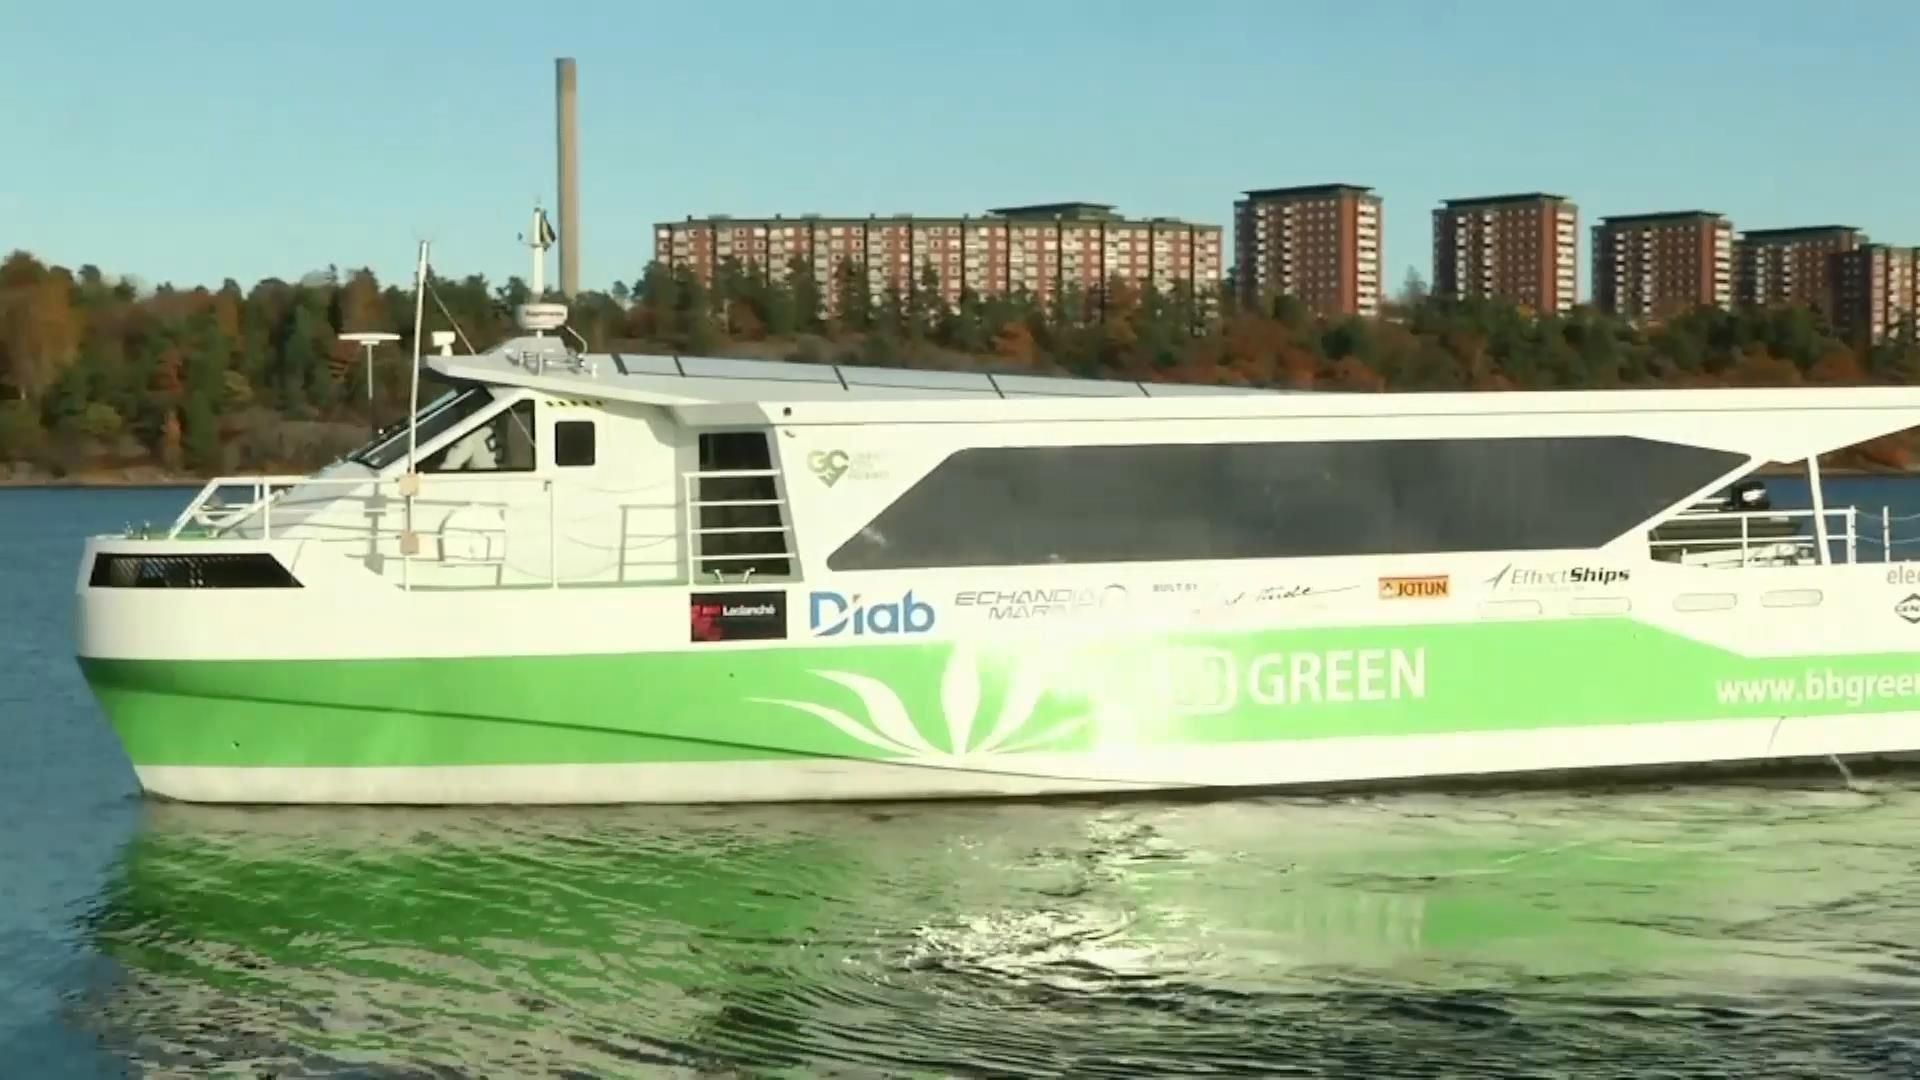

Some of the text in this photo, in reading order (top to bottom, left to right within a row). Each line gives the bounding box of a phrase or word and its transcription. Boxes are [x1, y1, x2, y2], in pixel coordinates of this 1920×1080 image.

[1511, 567, 1630, 585] EffectShips
[1887, 564, 1920, 584] ele
[1397, 580, 1448, 597] JOTUN
[809, 590, 936, 637] Diab
[1249, 648, 1426, 704] GREEN
